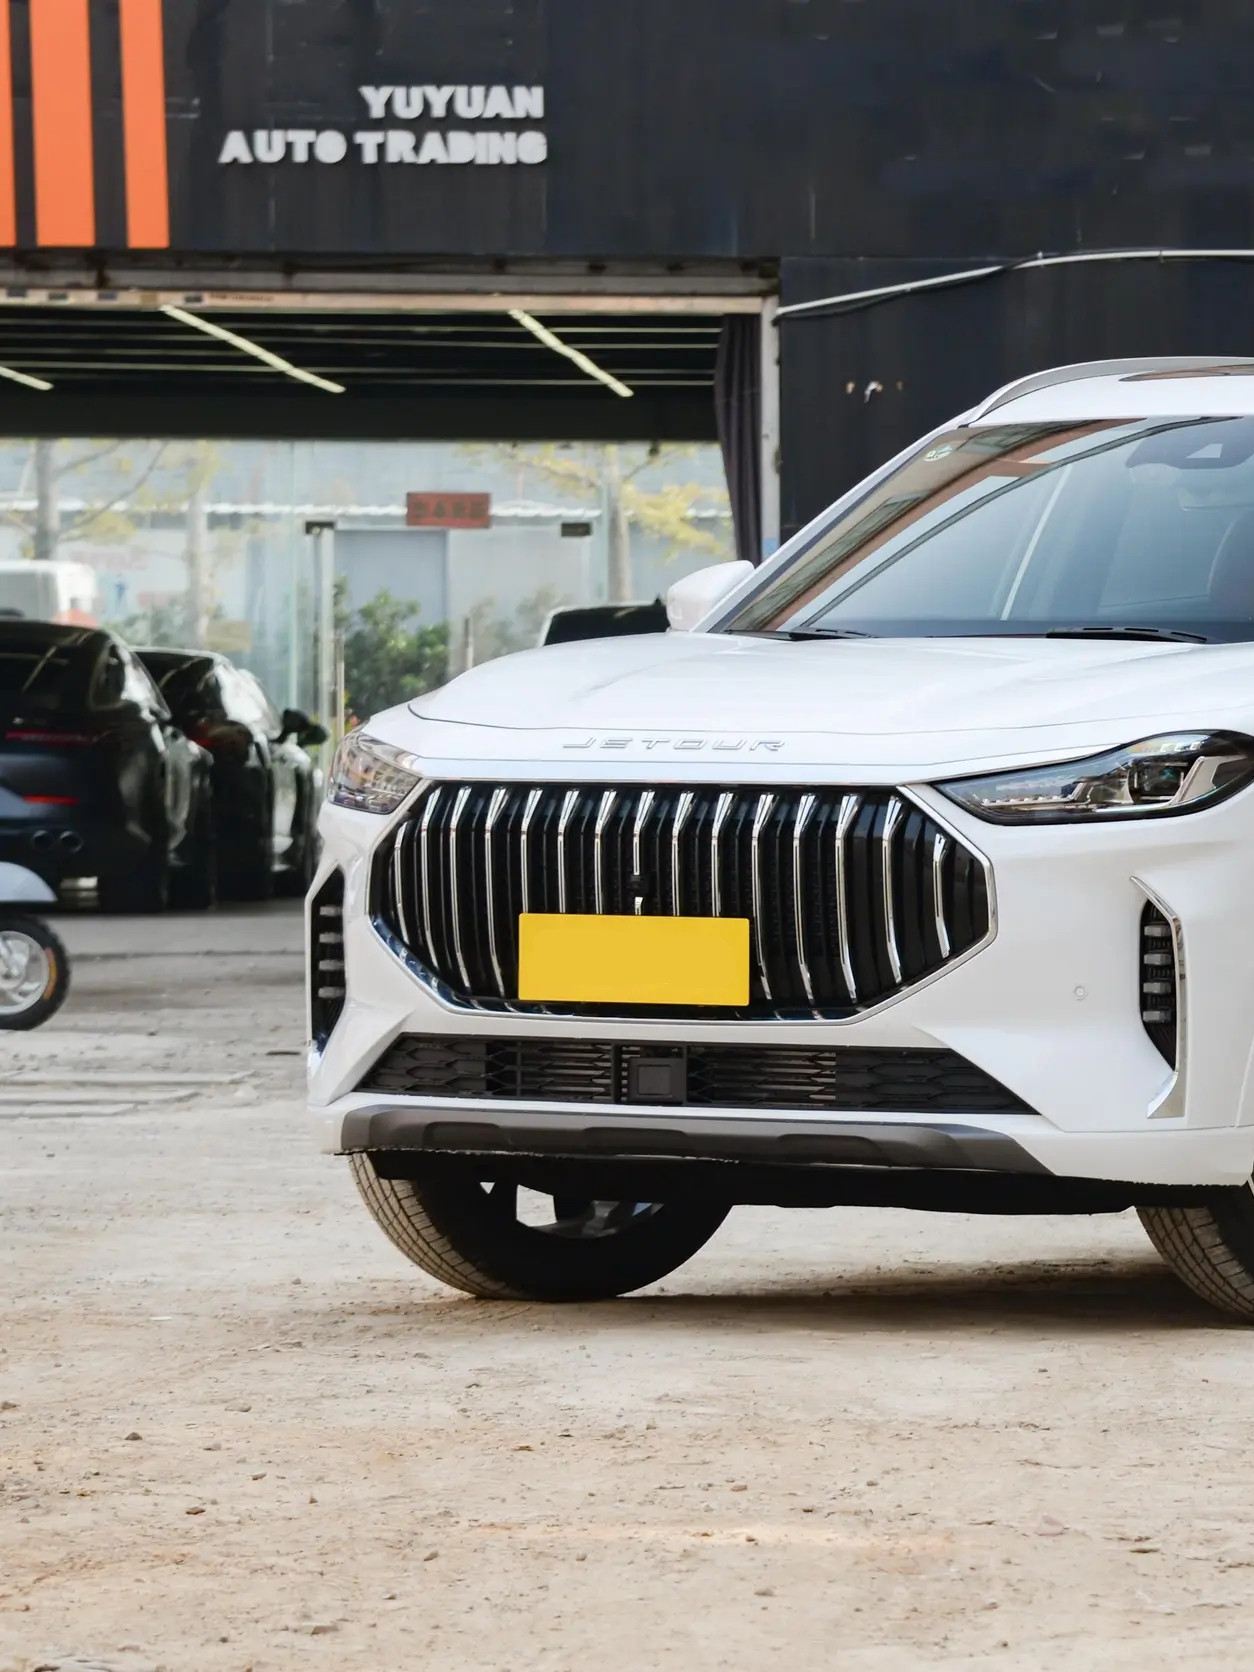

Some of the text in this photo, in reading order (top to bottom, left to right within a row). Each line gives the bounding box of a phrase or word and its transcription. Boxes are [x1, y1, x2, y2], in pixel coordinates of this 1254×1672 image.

[358, 85, 545, 119] YUYUAN
[218, 130, 548, 164] AUTO TRADING
[561, 736, 786, 752] JETOUR
